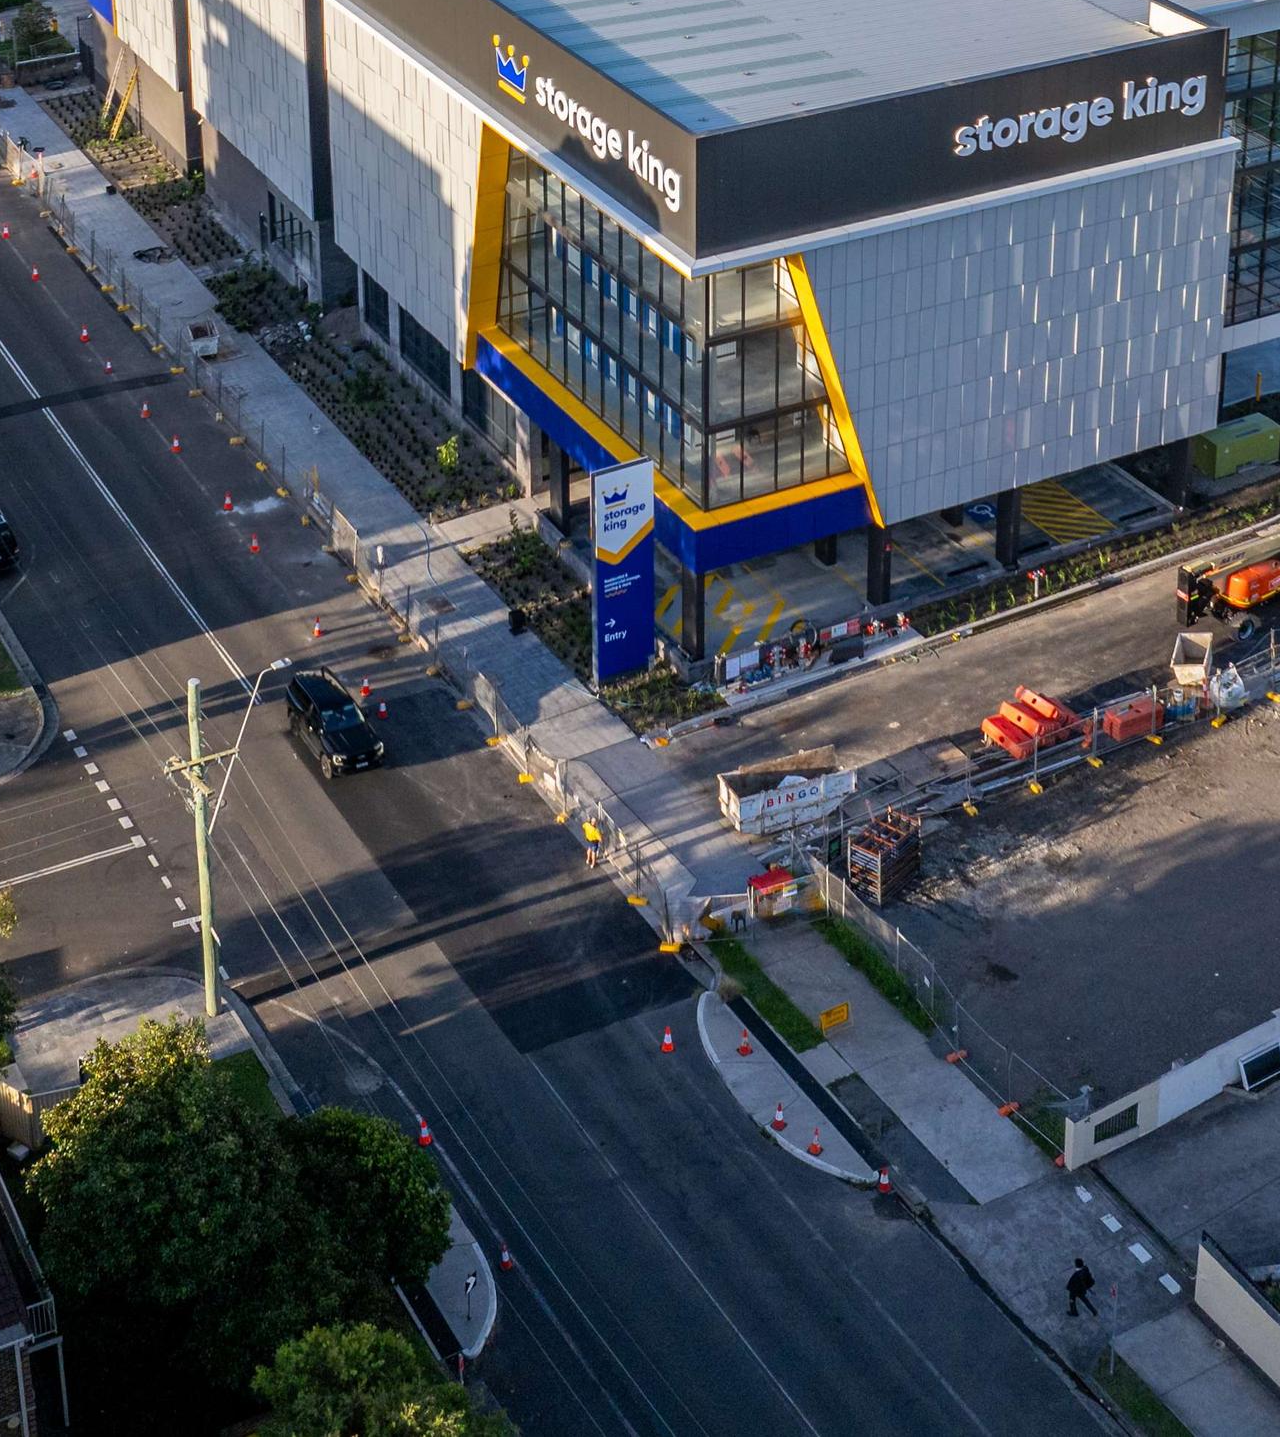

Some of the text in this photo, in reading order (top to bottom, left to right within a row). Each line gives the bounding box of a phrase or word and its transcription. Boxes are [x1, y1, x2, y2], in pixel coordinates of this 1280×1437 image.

[953, 75, 1208, 157] storage king
[535, 76, 682, 212] storage king
[604, 502, 646, 522] storage
[603, 519, 627, 532] king
[605, 629, 627, 643] Entry
[766, 786, 819, 808] BINGO
